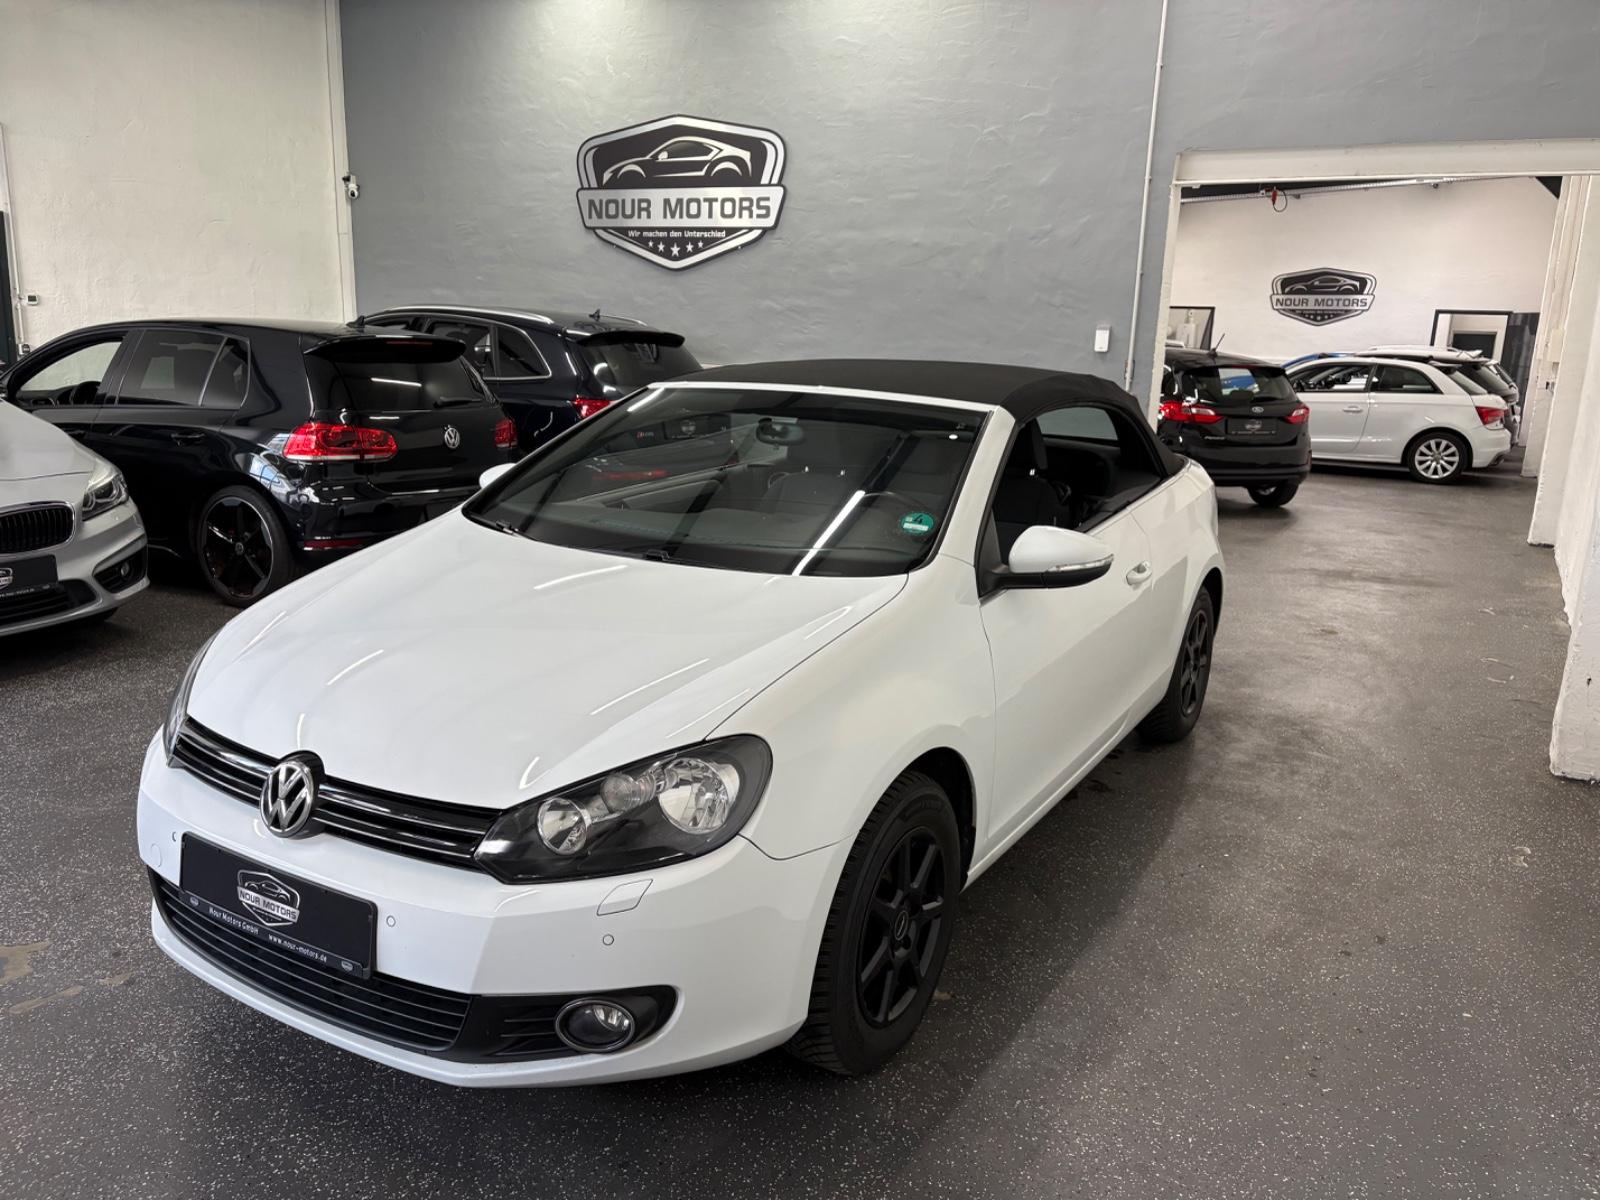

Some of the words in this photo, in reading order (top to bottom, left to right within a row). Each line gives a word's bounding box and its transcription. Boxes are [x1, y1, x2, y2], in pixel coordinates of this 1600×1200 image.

[587, 198, 652, 220] NOUR
[662, 196, 771, 220] MOTORS
[627, 229, 641, 238] Wir
[642, 229, 668, 238] machen
[669, 229, 682, 238] den
[683, 229, 726, 238] Unterschied
[1275, 298, 1309, 307] NOUR
[1313, 298, 1368, 307] MOTORS
[239, 889, 261, 906] NOUR
[262, 899, 298, 920] MOTORS
[222, 910, 242, 928] Motors
